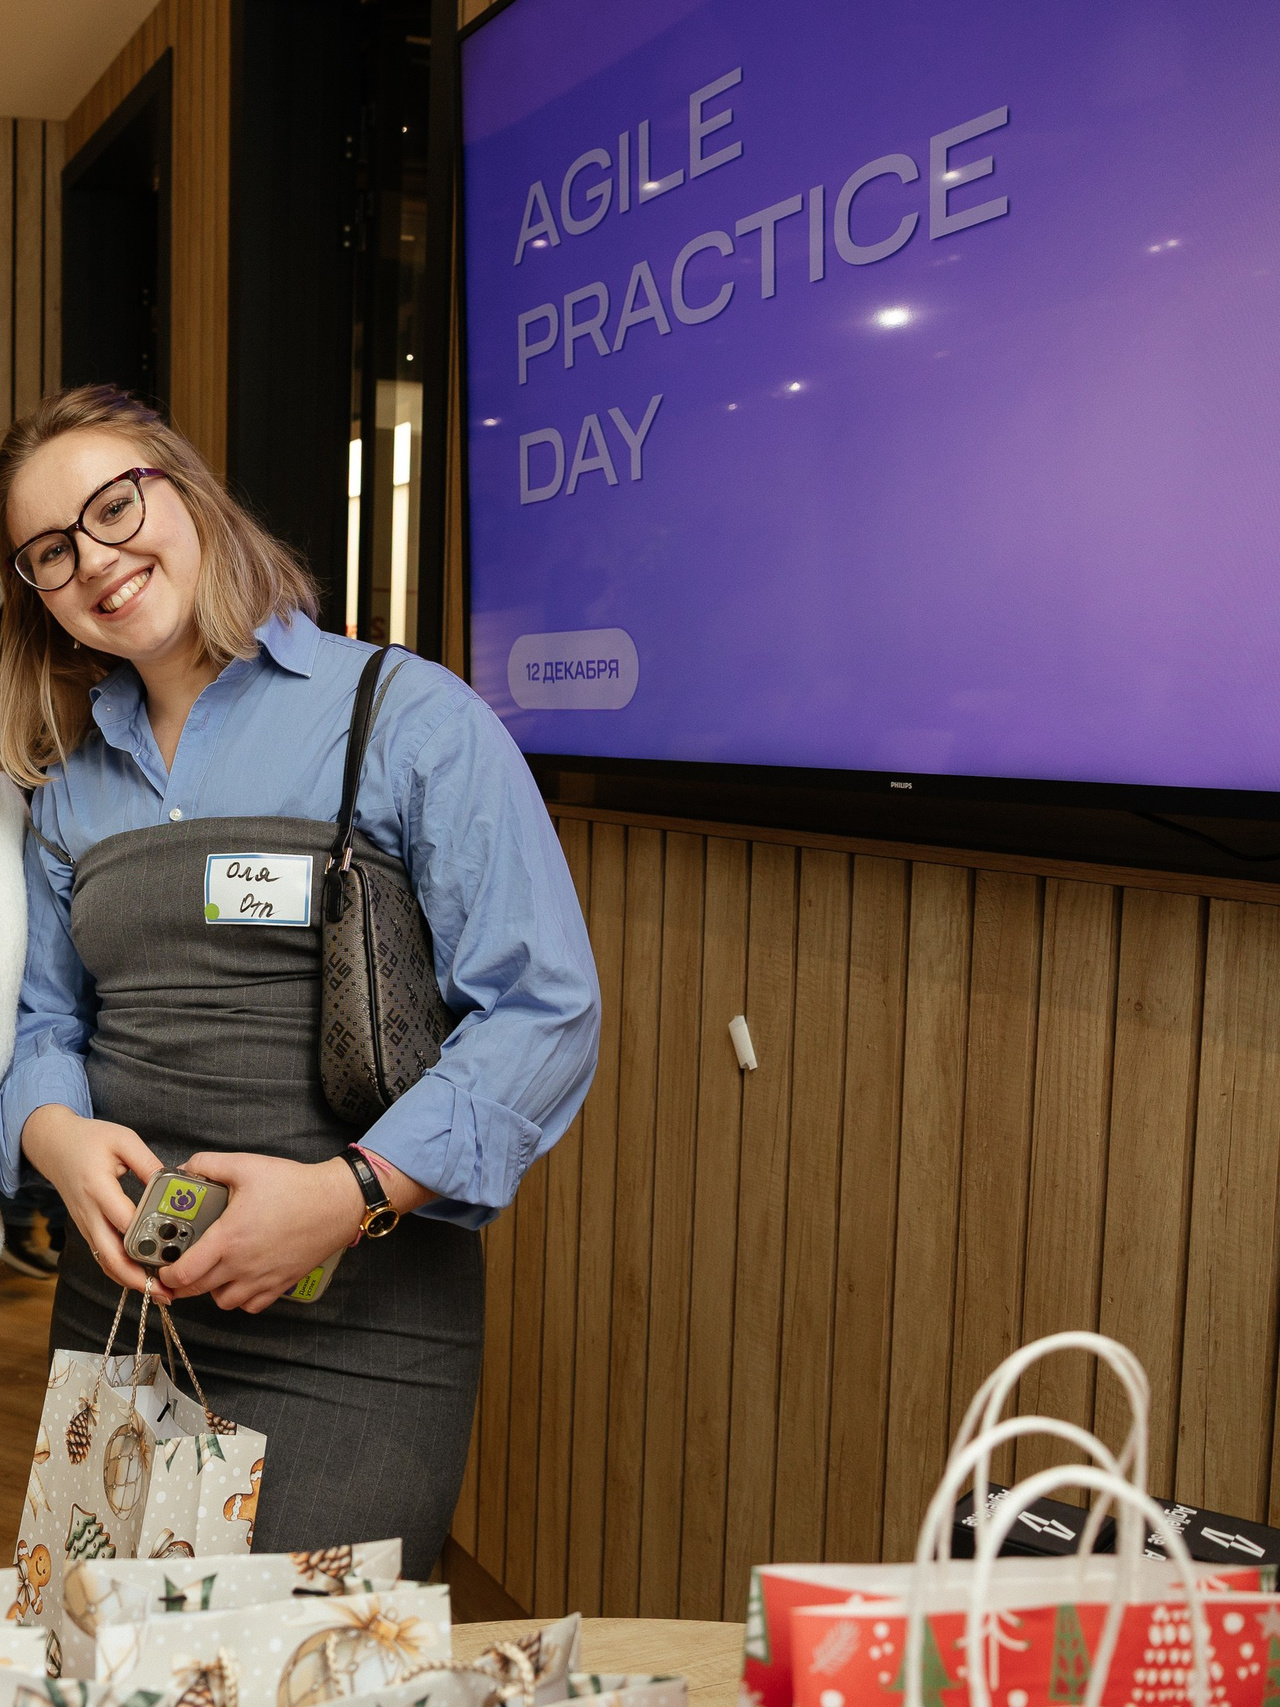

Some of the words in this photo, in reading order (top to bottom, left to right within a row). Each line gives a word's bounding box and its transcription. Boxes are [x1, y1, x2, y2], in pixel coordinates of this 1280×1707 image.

[513, 66, 743, 267] AGILE
[518, 104, 1009, 386] PRACTICE
[520, 393, 664, 506] DAY
[525, 662, 540, 681] 12
[543, 659, 619, 684] ДЕКАБРЯ
[890, 781, 913, 790] PHILIPS
[226, 861, 282, 883] Оля
